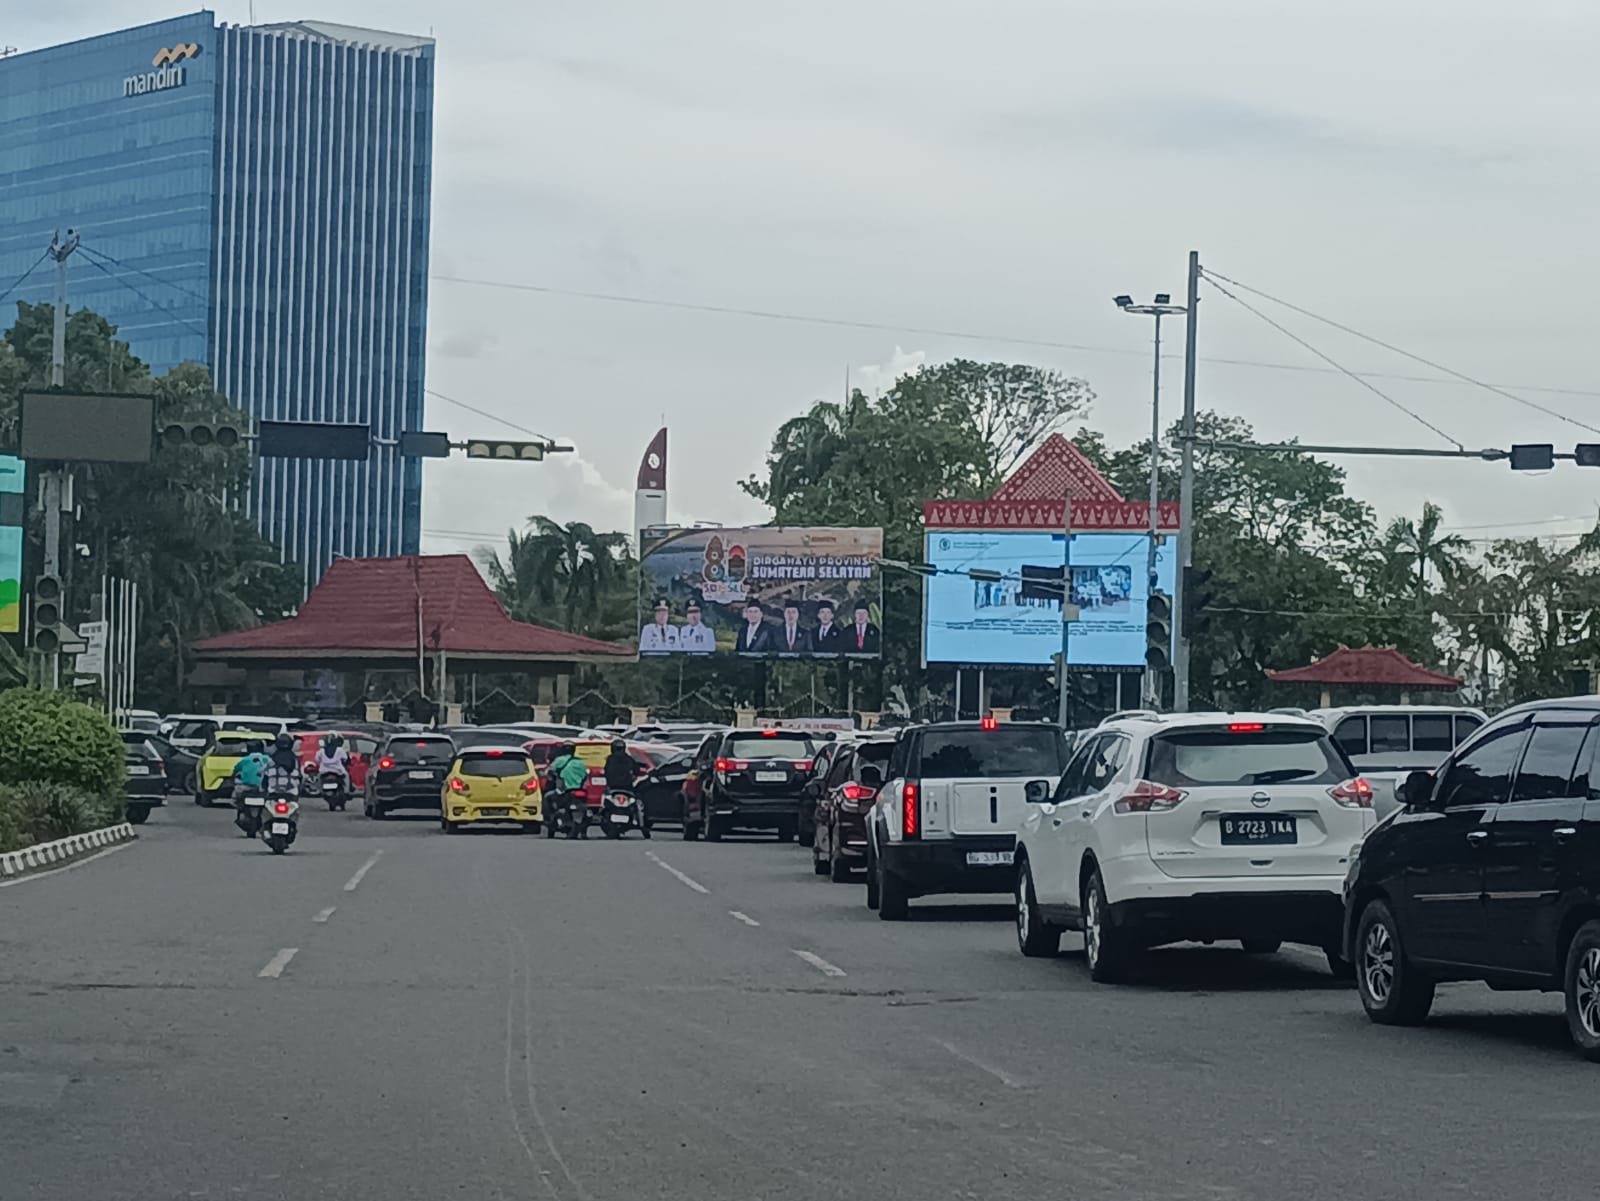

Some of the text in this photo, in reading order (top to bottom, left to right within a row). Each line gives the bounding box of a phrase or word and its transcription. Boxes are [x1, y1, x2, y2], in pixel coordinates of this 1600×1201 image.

[123, 62, 182, 96] mandiri
[753, 556, 817, 566] DIRGAHAYU
[752, 566, 872, 578] SUMATERA SELATAN
[1225, 820, 1293, 834] B 2723 TKA
